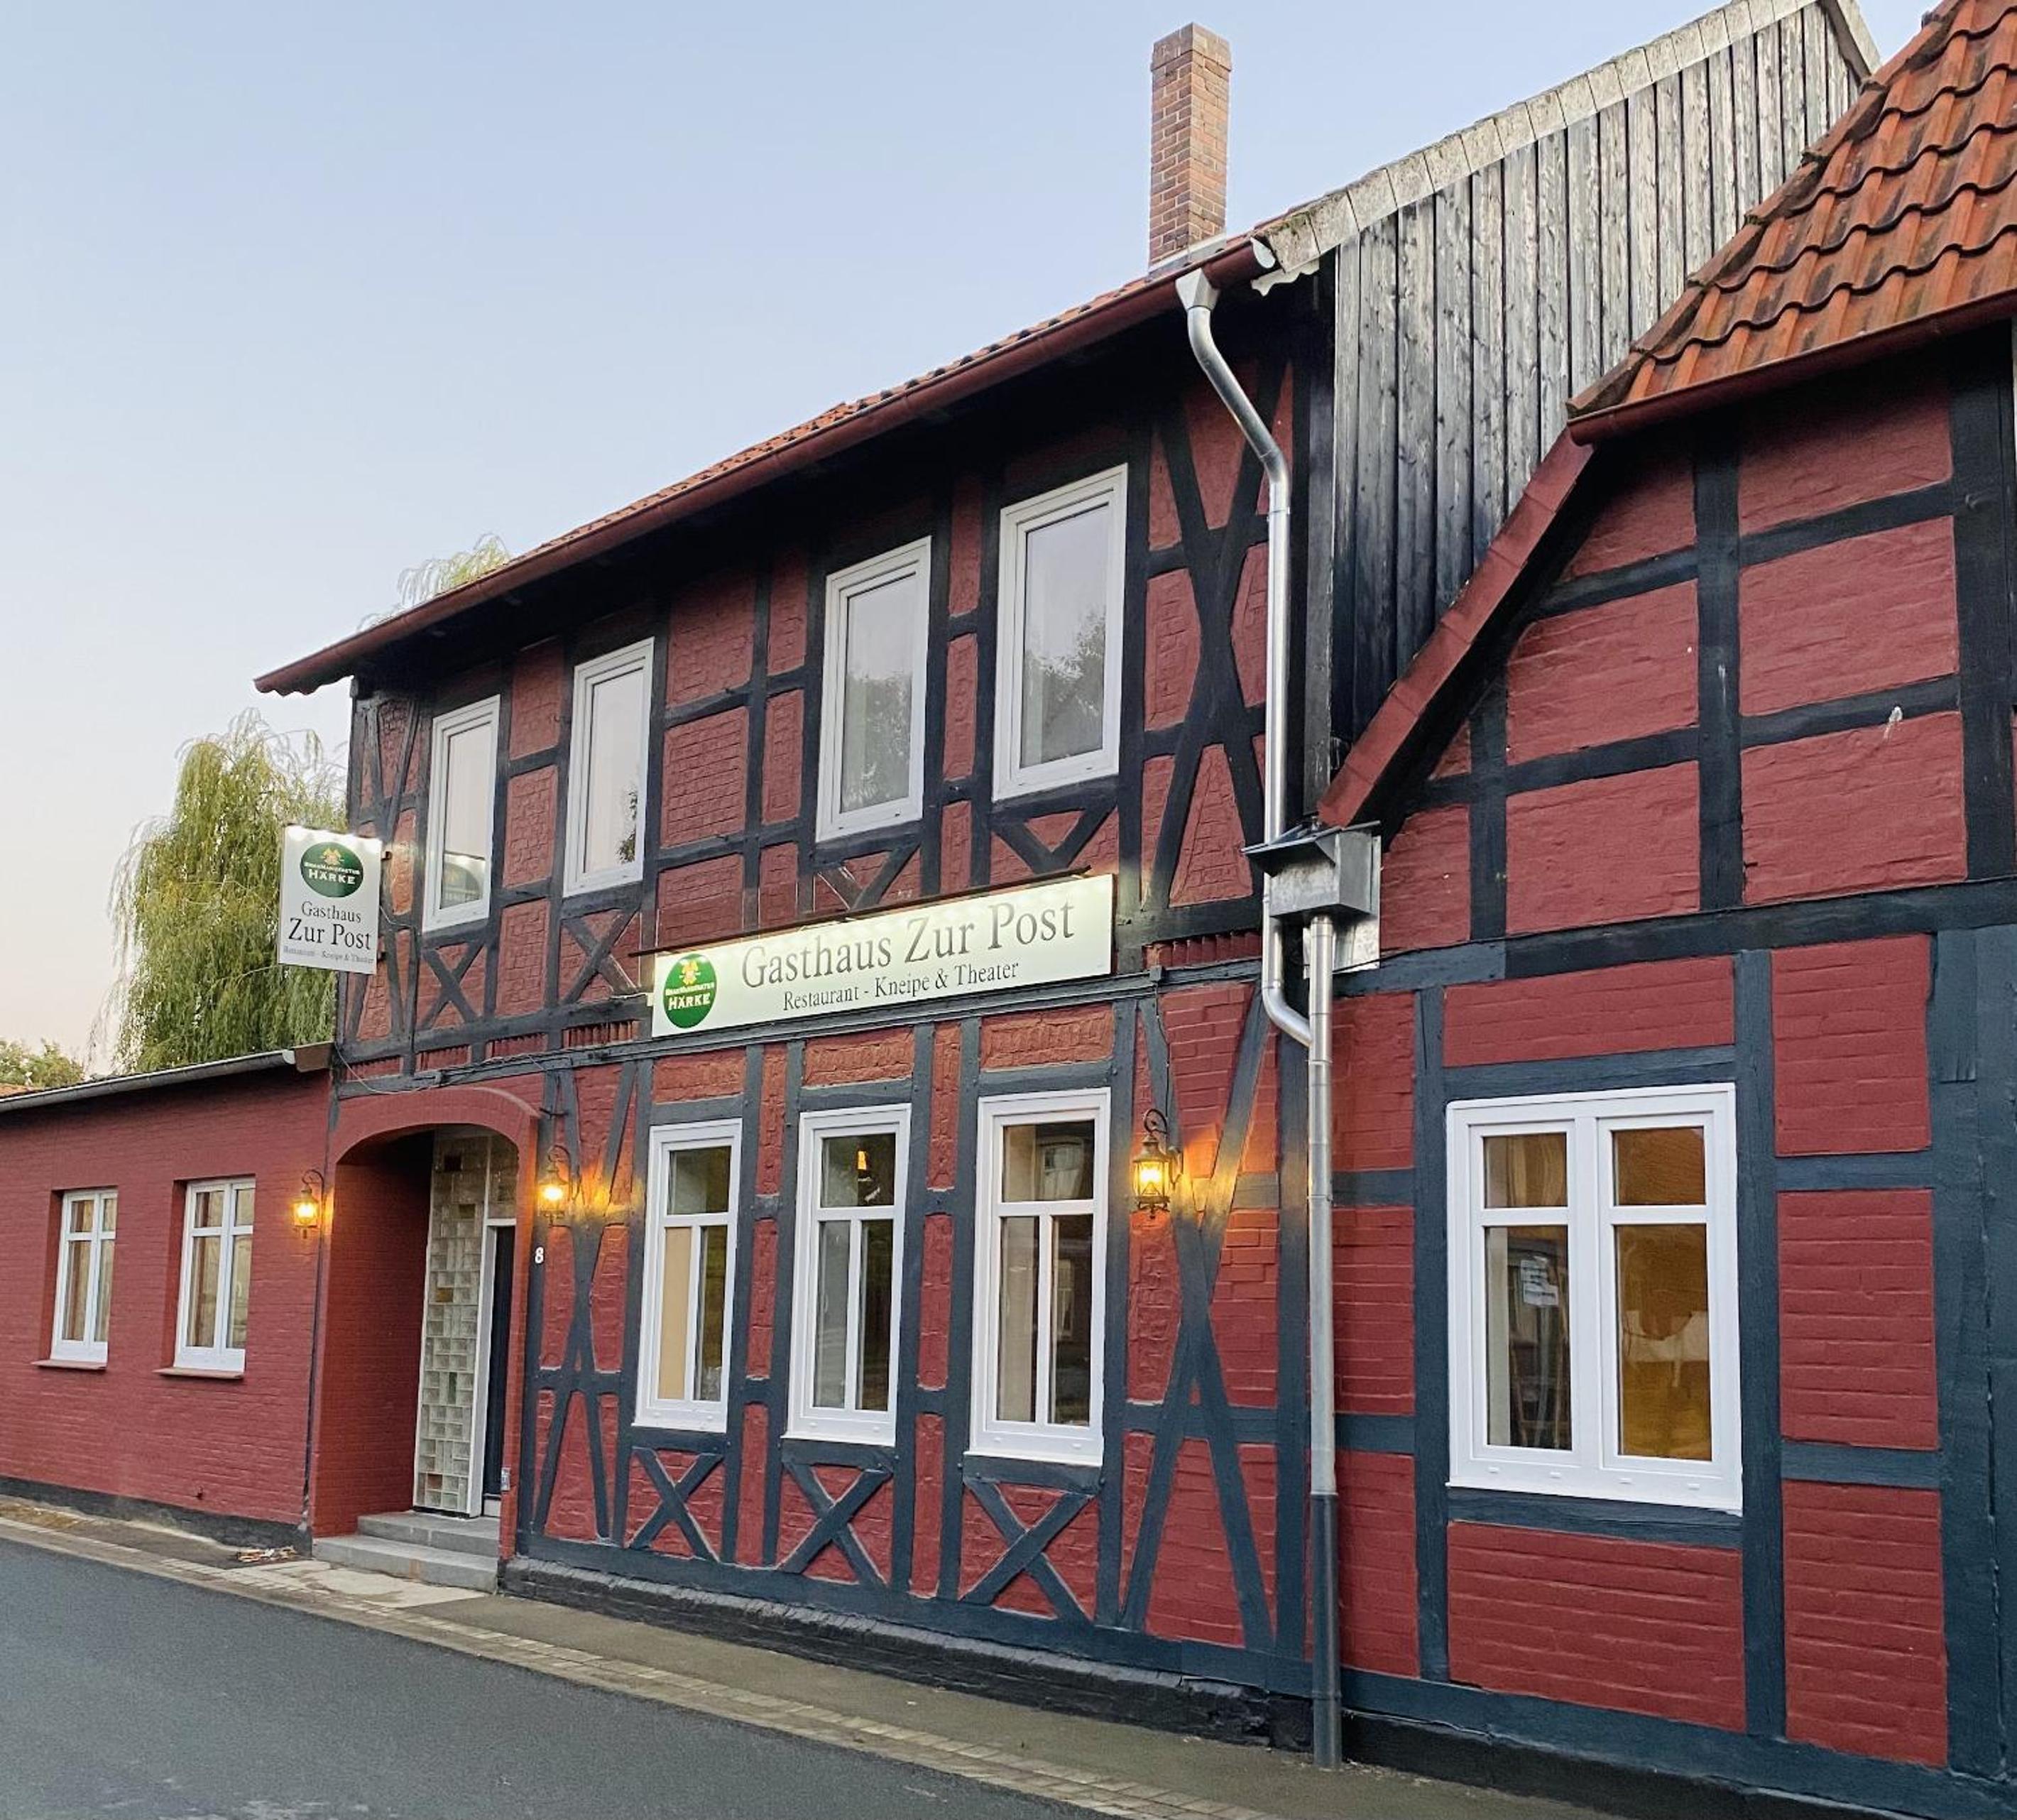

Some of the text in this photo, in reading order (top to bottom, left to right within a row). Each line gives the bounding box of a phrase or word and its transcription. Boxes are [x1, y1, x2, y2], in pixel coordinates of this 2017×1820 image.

[308, 868, 356, 884] HÄRKE
[302, 900, 361, 923] Gasthaus
[288, 917, 371, 950] Zur Post
[742, 899, 1075, 988] Gasthaus Zur Post
[783, 986, 859, 1011] Restaurant
[875, 974, 929, 998] Kneipe
[934, 968, 949, 989] &
[954, 962, 1019, 986] Theater
[667, 992, 711, 1010] HÄRKE
[534, 1246, 545, 1264] 8
